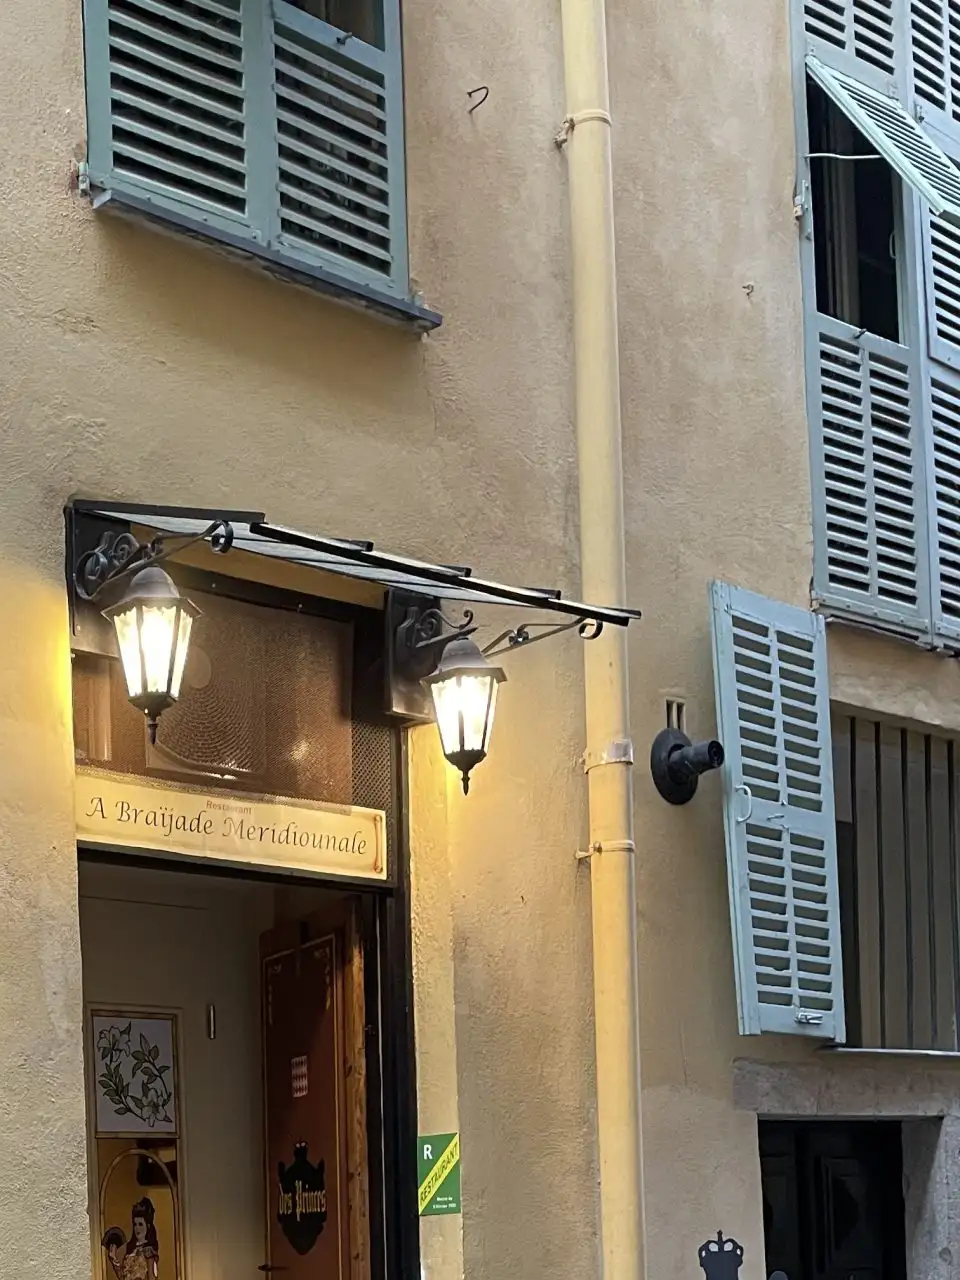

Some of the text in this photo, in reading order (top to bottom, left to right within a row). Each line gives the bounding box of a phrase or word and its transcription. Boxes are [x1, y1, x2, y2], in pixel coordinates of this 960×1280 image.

[85, 797, 107, 820] A
[222, 815, 368, 855] Meridiounale
[205, 800, 253, 815] Restaurant
[424, 1145, 433, 1159] R
[420, 1143, 458, 1204] RESTAURANT
[279, 1180, 327, 1221] des Princes
